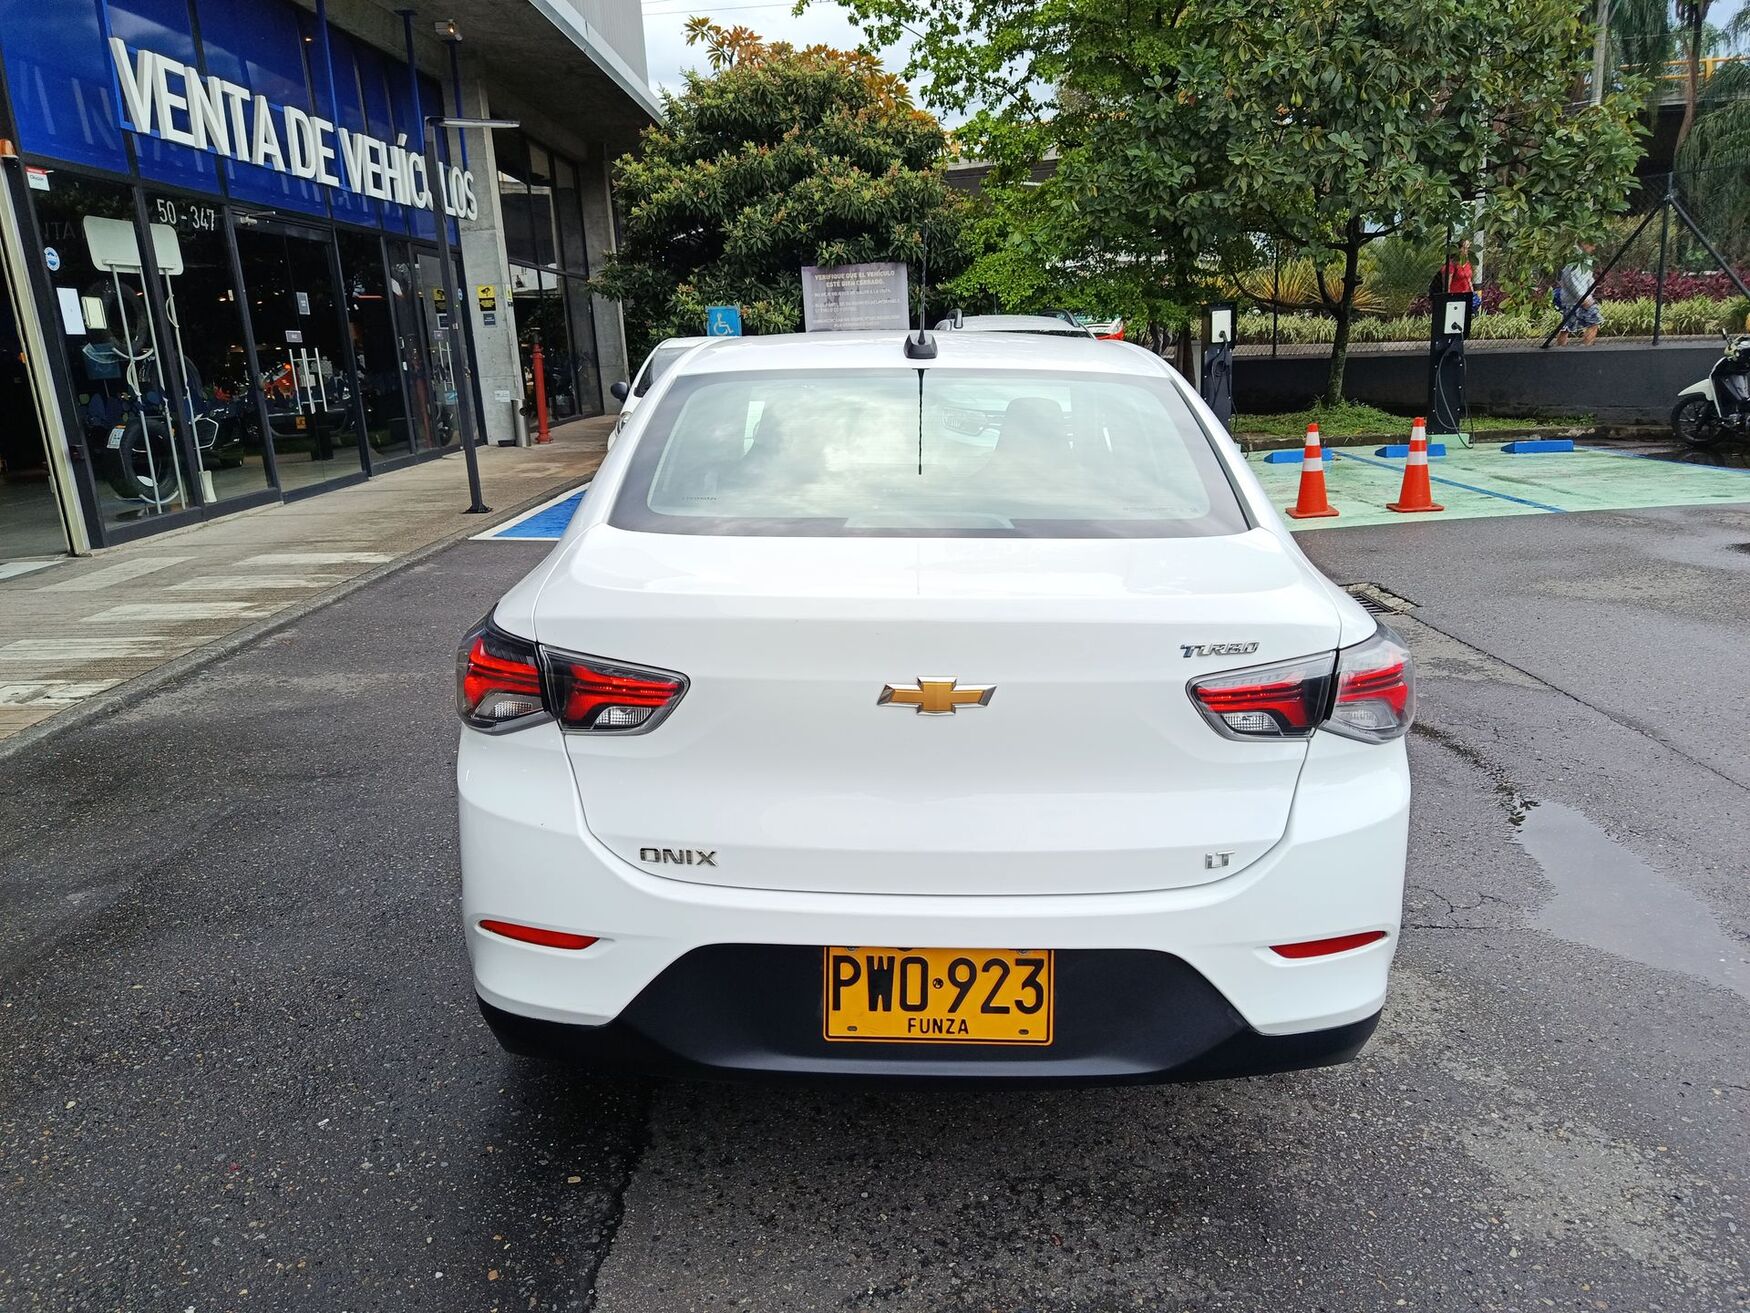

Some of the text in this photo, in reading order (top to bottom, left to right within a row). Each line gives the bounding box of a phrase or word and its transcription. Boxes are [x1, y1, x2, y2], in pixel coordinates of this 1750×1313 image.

[109, 37, 478, 221] VENTA DE VEHÍCLOS
[157, 199, 177, 224] 50
[190, 205, 214, 231] 347
[846, 272, 857, 280] QUE
[859, 271, 866, 279] EL
[1180, 642, 1260, 658] TURBO
[640, 848, 718, 867] ONIX
[1205, 850, 1235, 869] LT
[907, 1017, 969, 1035] FUNZA
